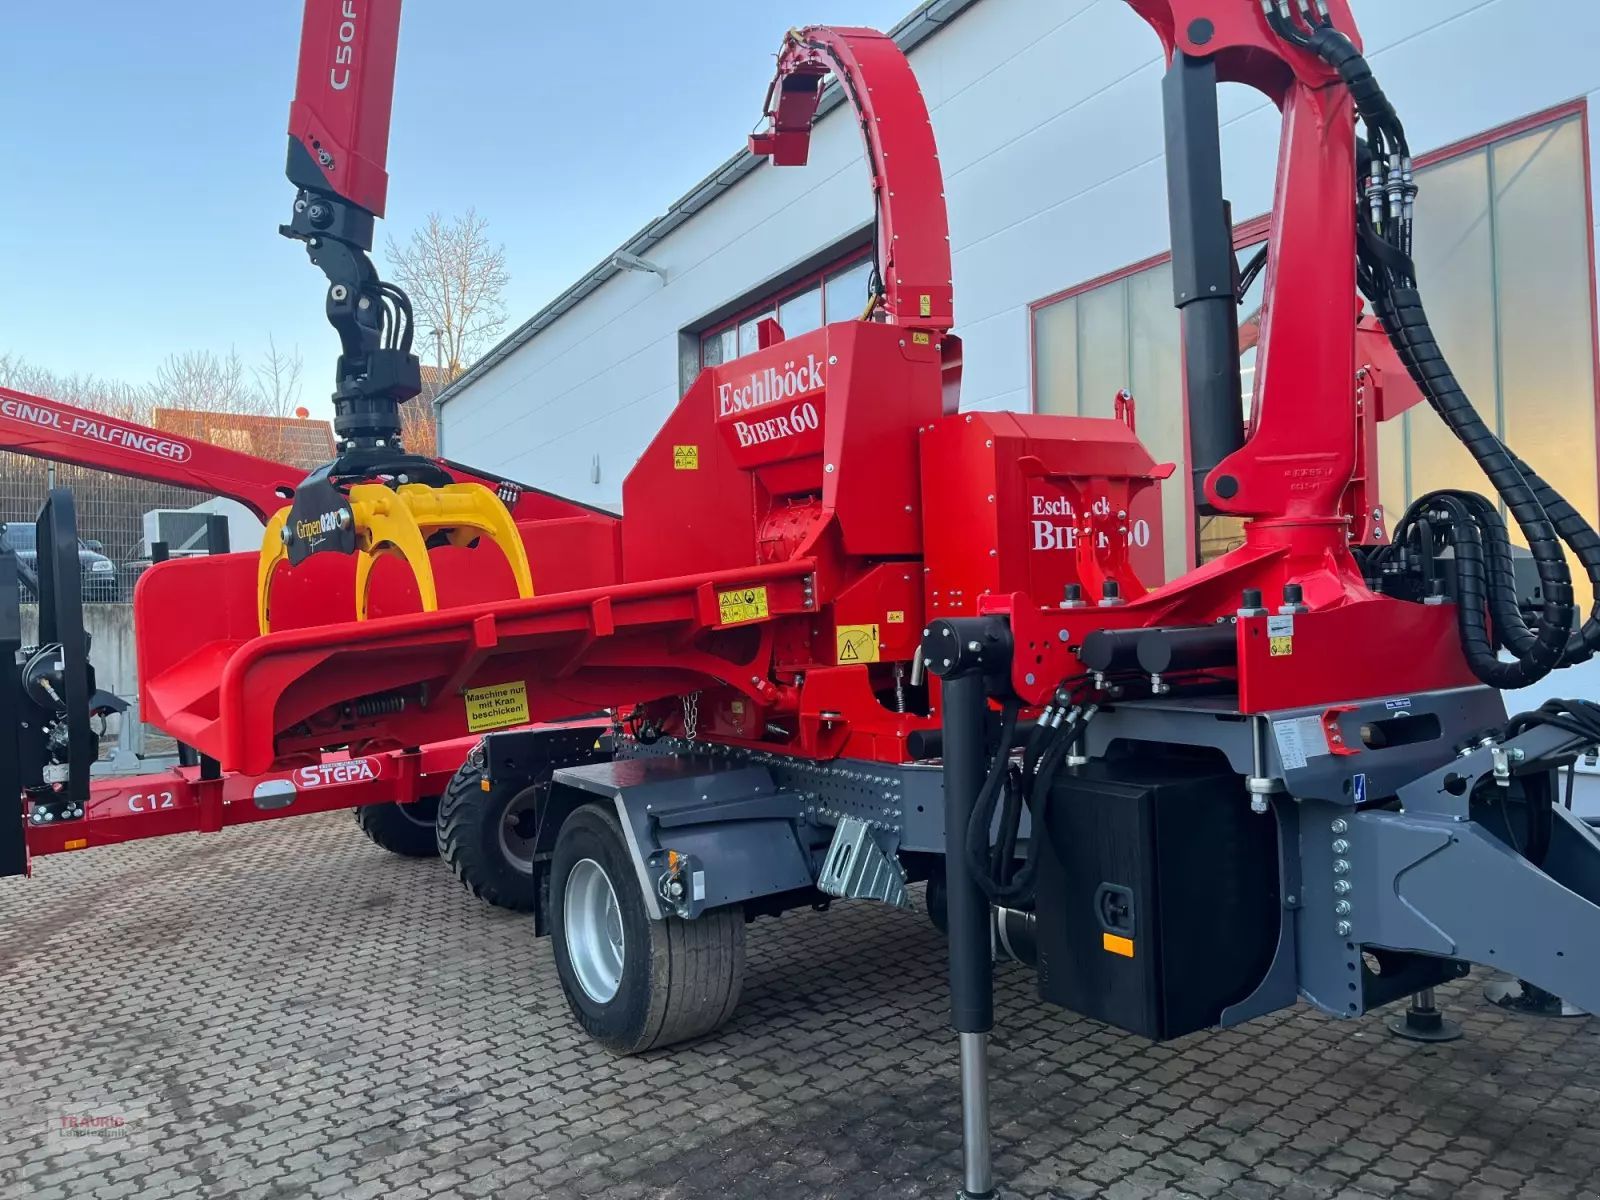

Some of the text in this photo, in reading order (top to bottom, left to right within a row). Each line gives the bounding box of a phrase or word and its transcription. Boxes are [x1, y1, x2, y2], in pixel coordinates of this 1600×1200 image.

[718, 354, 825, 417] Eschlböck
[1032, 495, 1110, 516] Eschck
[467, 687, 525, 702] Maschine nur
[479, 697, 516, 710] mit Kran
[472, 703, 524, 720] beschicken!
[300, 763, 374, 787] STEPA
